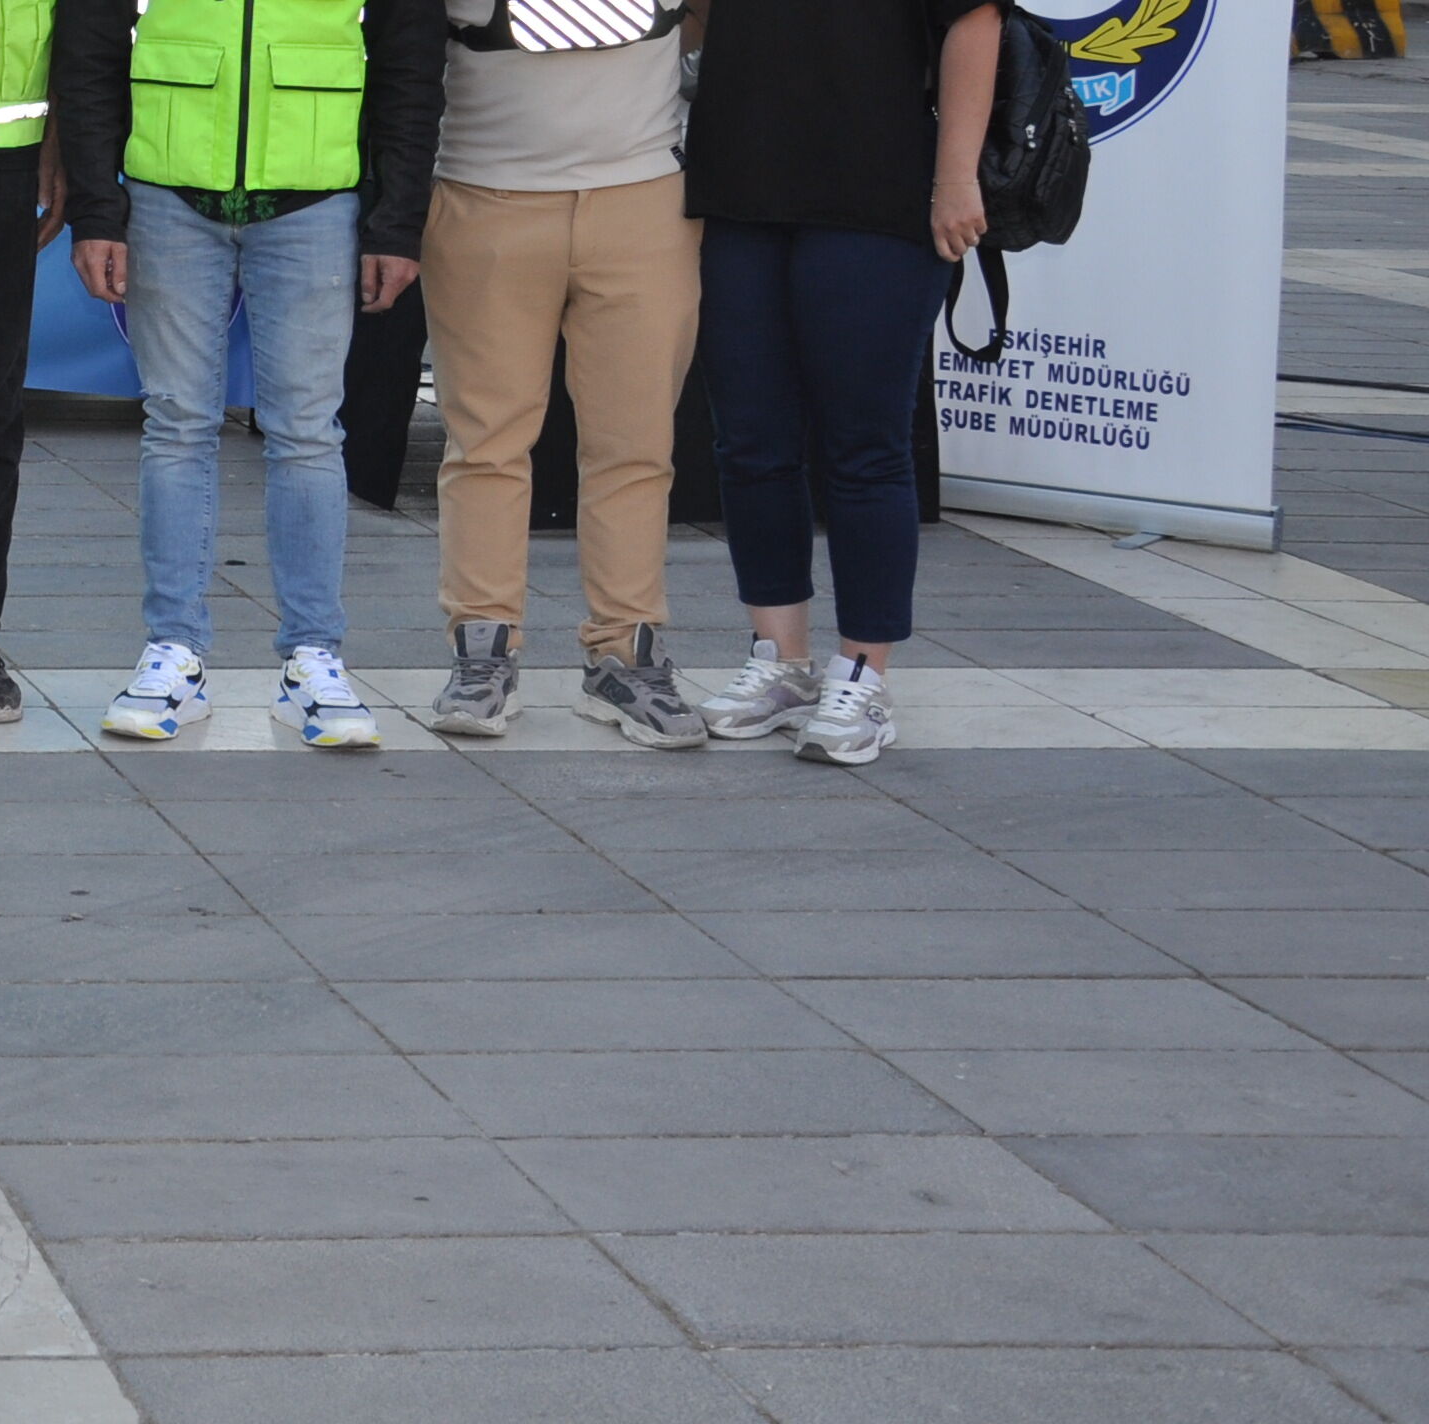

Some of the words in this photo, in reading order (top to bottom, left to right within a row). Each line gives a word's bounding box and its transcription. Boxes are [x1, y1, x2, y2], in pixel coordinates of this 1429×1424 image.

[1047, 360, 1191, 397] MÜDÜRLÜĞÜ
[934, 379, 1013, 407] TRAFİK
[1025, 389, 1159, 423] DENETLEME
[939, 408, 997, 433] ŞUBE
[1008, 414, 1151, 450] MÜDÜRLÜĞÜ
